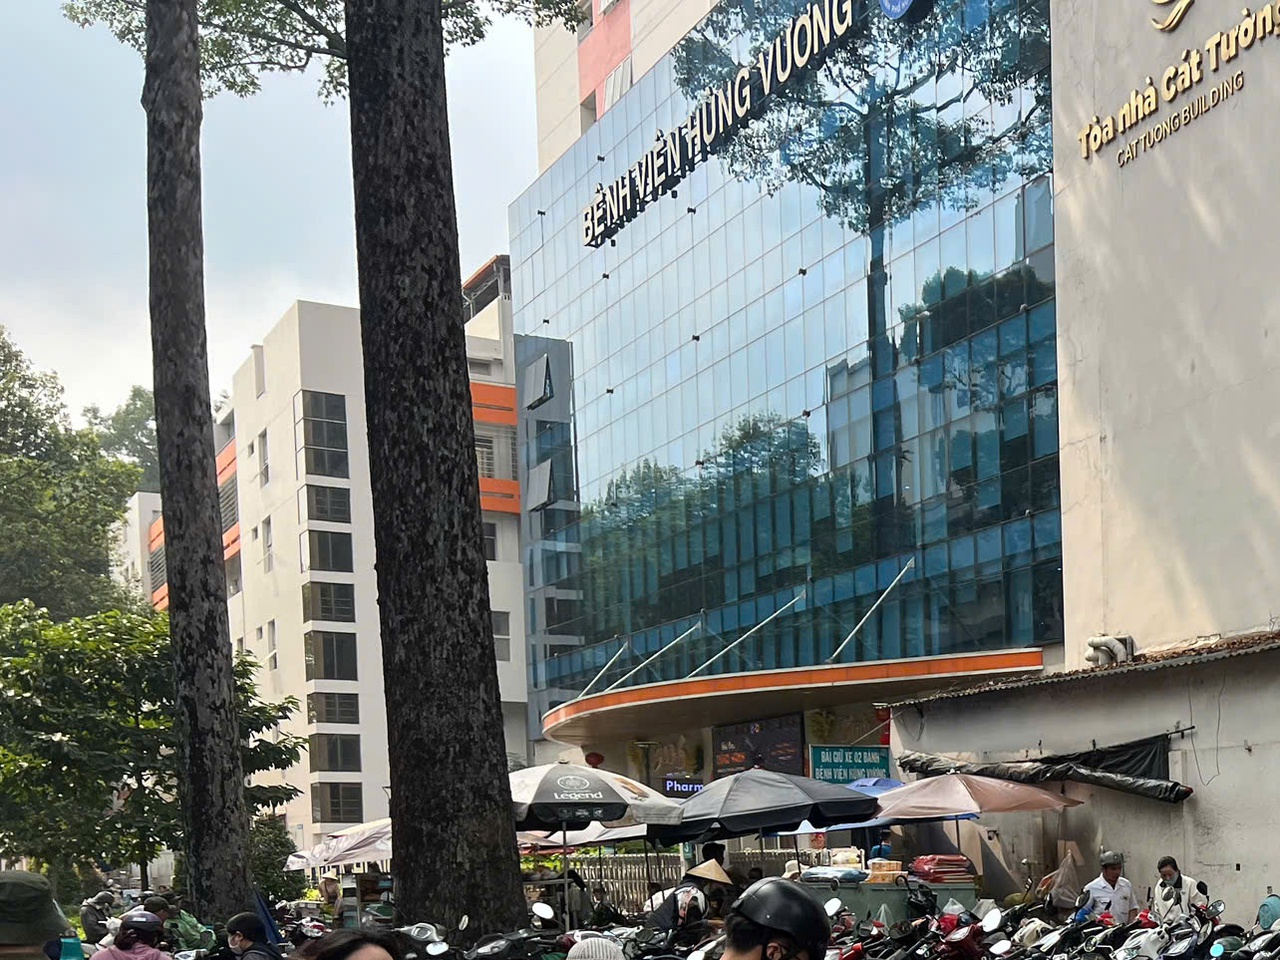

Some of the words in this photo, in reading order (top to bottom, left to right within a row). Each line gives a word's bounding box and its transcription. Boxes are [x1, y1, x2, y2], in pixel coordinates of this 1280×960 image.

[1077, 115, 1116, 158] Tòa
[1117, 76, 1158, 134] nhà
[1160, 49, 1202, 102] Cát
[1115, 140, 1142, 167] CAT
[1139, 112, 1182, 149] TUONG
[1181, 70, 1245, 127] BUILDING
[845, 752, 853, 763] XE
[854, 752, 862, 763] 02
[554, 791, 603, 800] Legend
